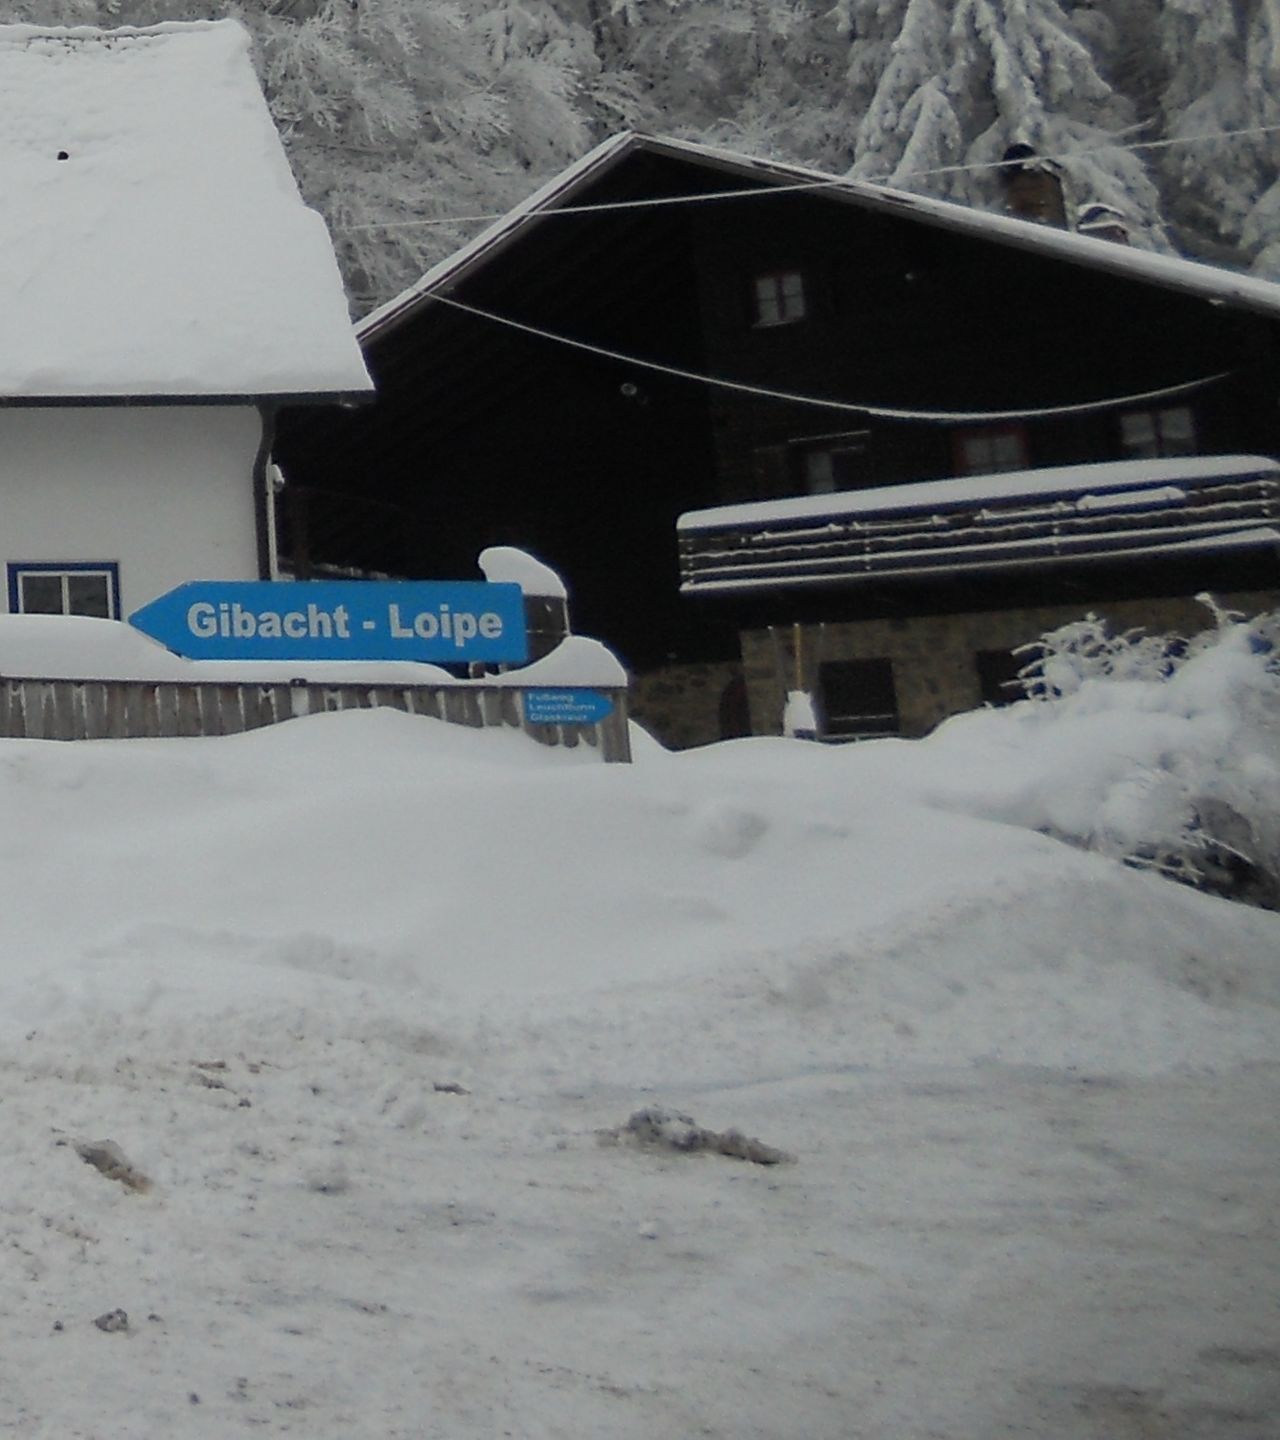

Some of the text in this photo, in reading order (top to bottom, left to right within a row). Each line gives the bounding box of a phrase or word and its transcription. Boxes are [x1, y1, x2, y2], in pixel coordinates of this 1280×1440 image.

[186, 601, 503, 647] Gibacht - Loipe
